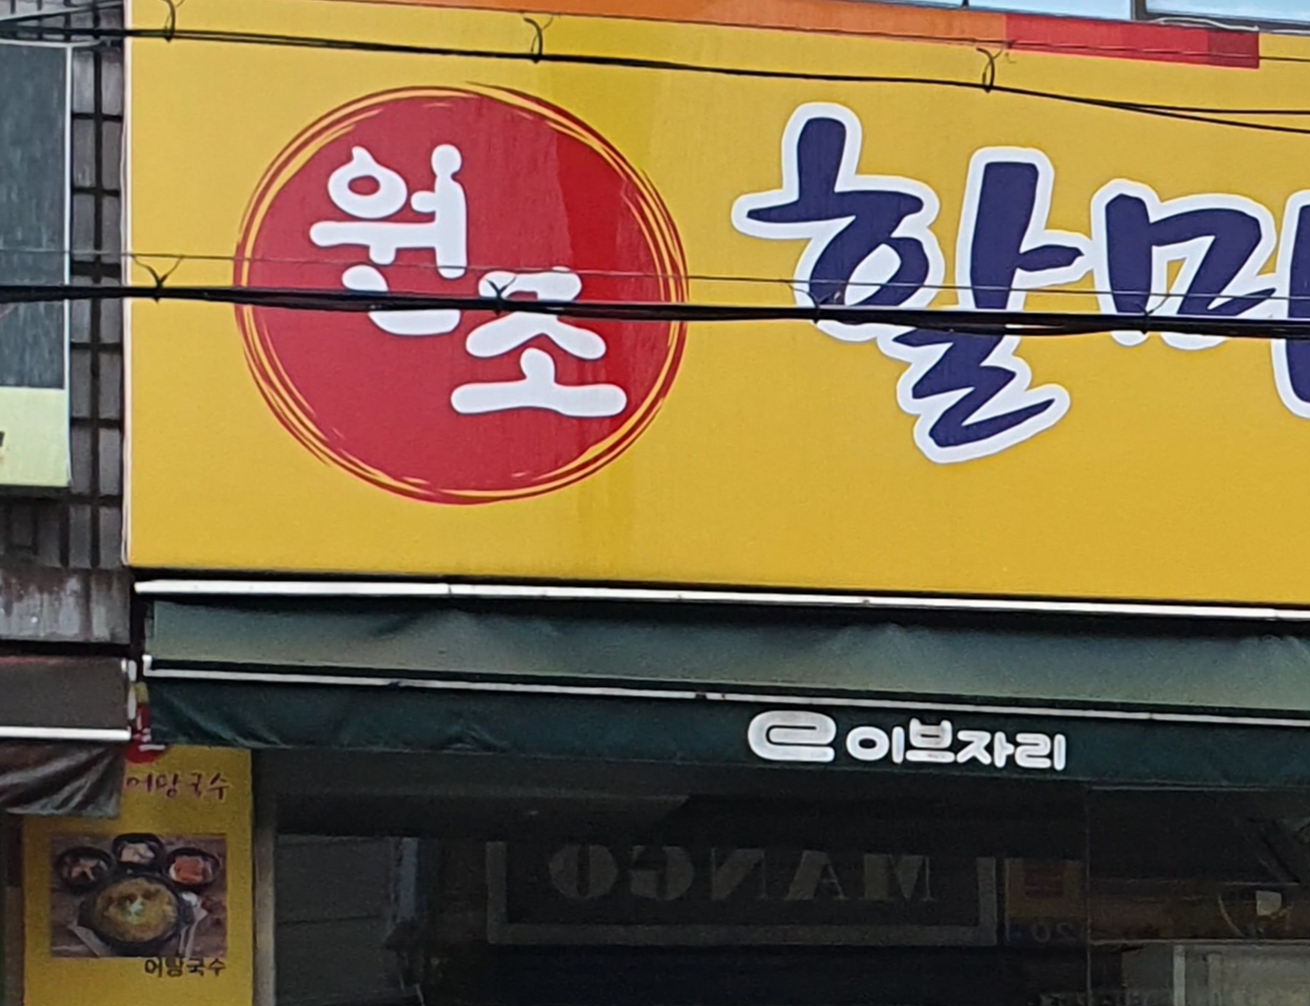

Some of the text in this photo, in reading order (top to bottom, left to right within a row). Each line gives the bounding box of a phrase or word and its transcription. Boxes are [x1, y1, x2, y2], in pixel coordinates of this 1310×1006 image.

[310, 145, 627, 417] 원조
[846, 717, 1067, 771] 이브자리
[126, 772, 230, 800] 어탕국수
